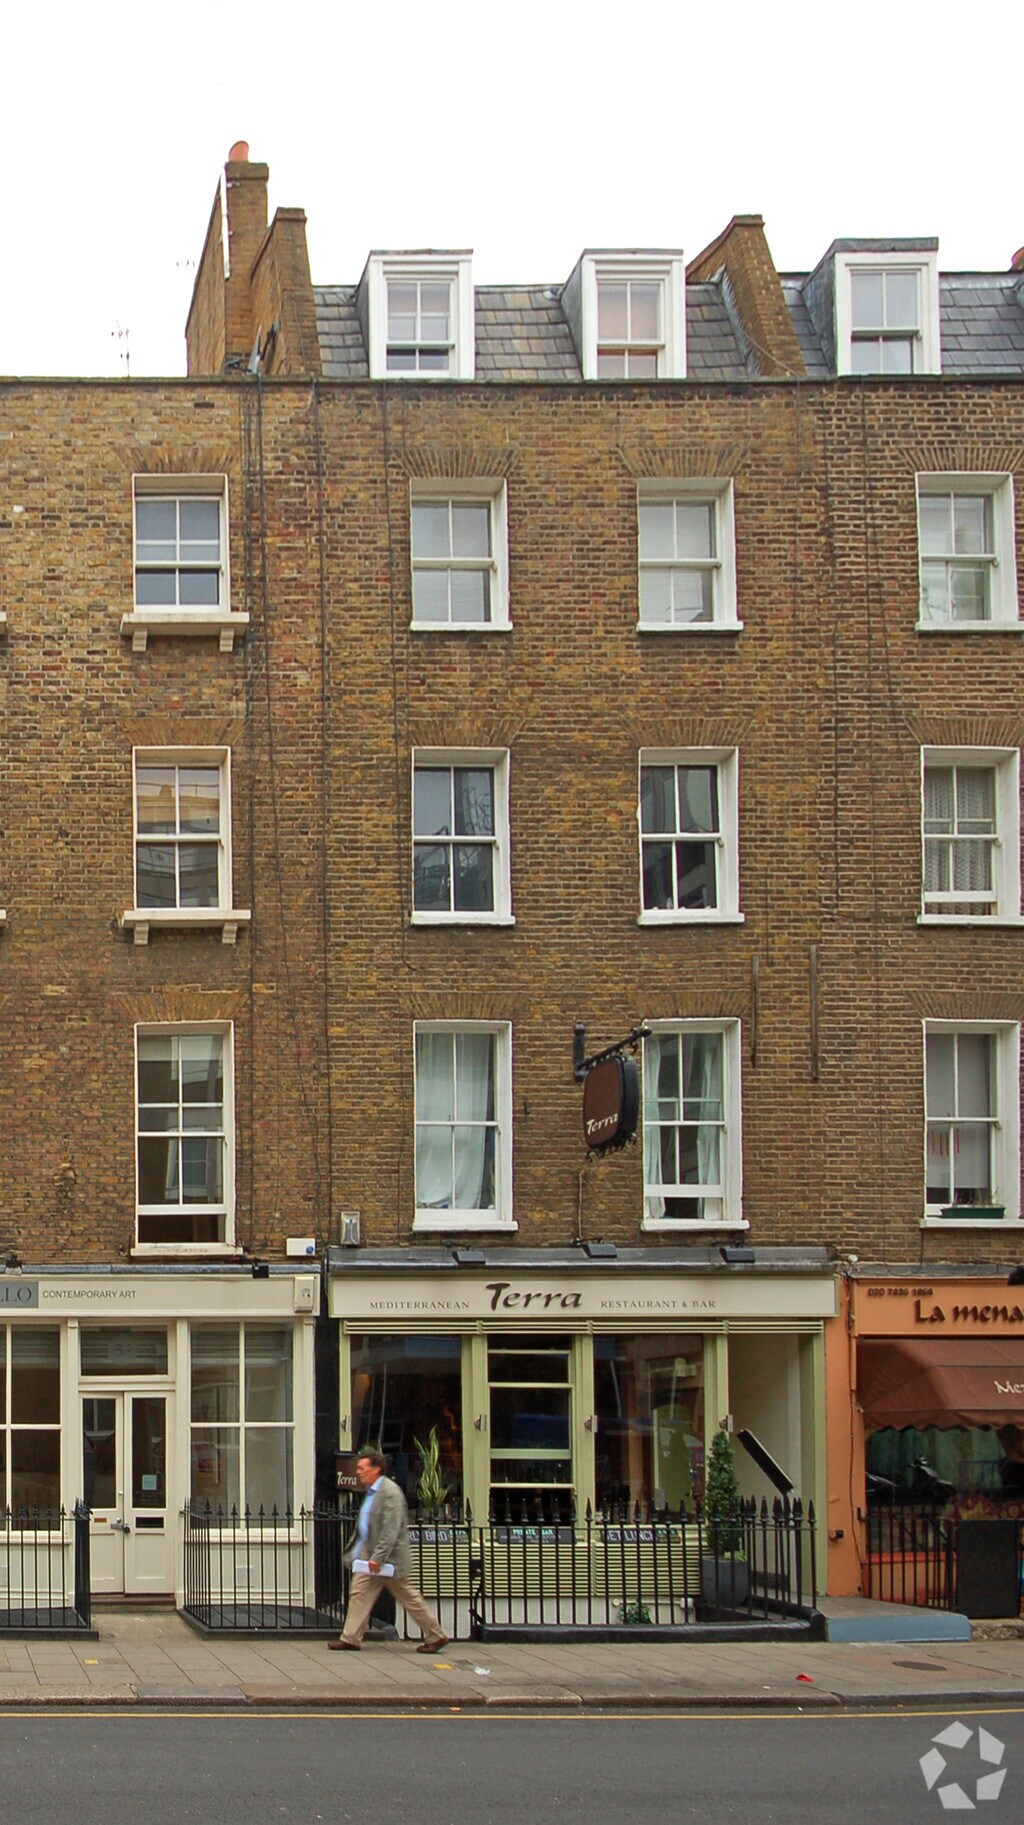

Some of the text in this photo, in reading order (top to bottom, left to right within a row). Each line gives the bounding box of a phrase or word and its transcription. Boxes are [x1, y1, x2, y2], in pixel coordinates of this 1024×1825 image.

[587, 1113, 618, 1136] Terra
[42, 1290, 137, 1299] CONTEMPORARY ART
[486, 1282, 583, 1311] Terra
[868, 1288, 885, 1298] 020
[370, 1301, 470, 1309] MEDITERRANEAN
[600, 1300, 677, 1308] RESTAURANT
[692, 1300, 716, 1308] BAR
[914, 1299, 946, 1323] La
[337, 1471, 357, 1486] Terra
